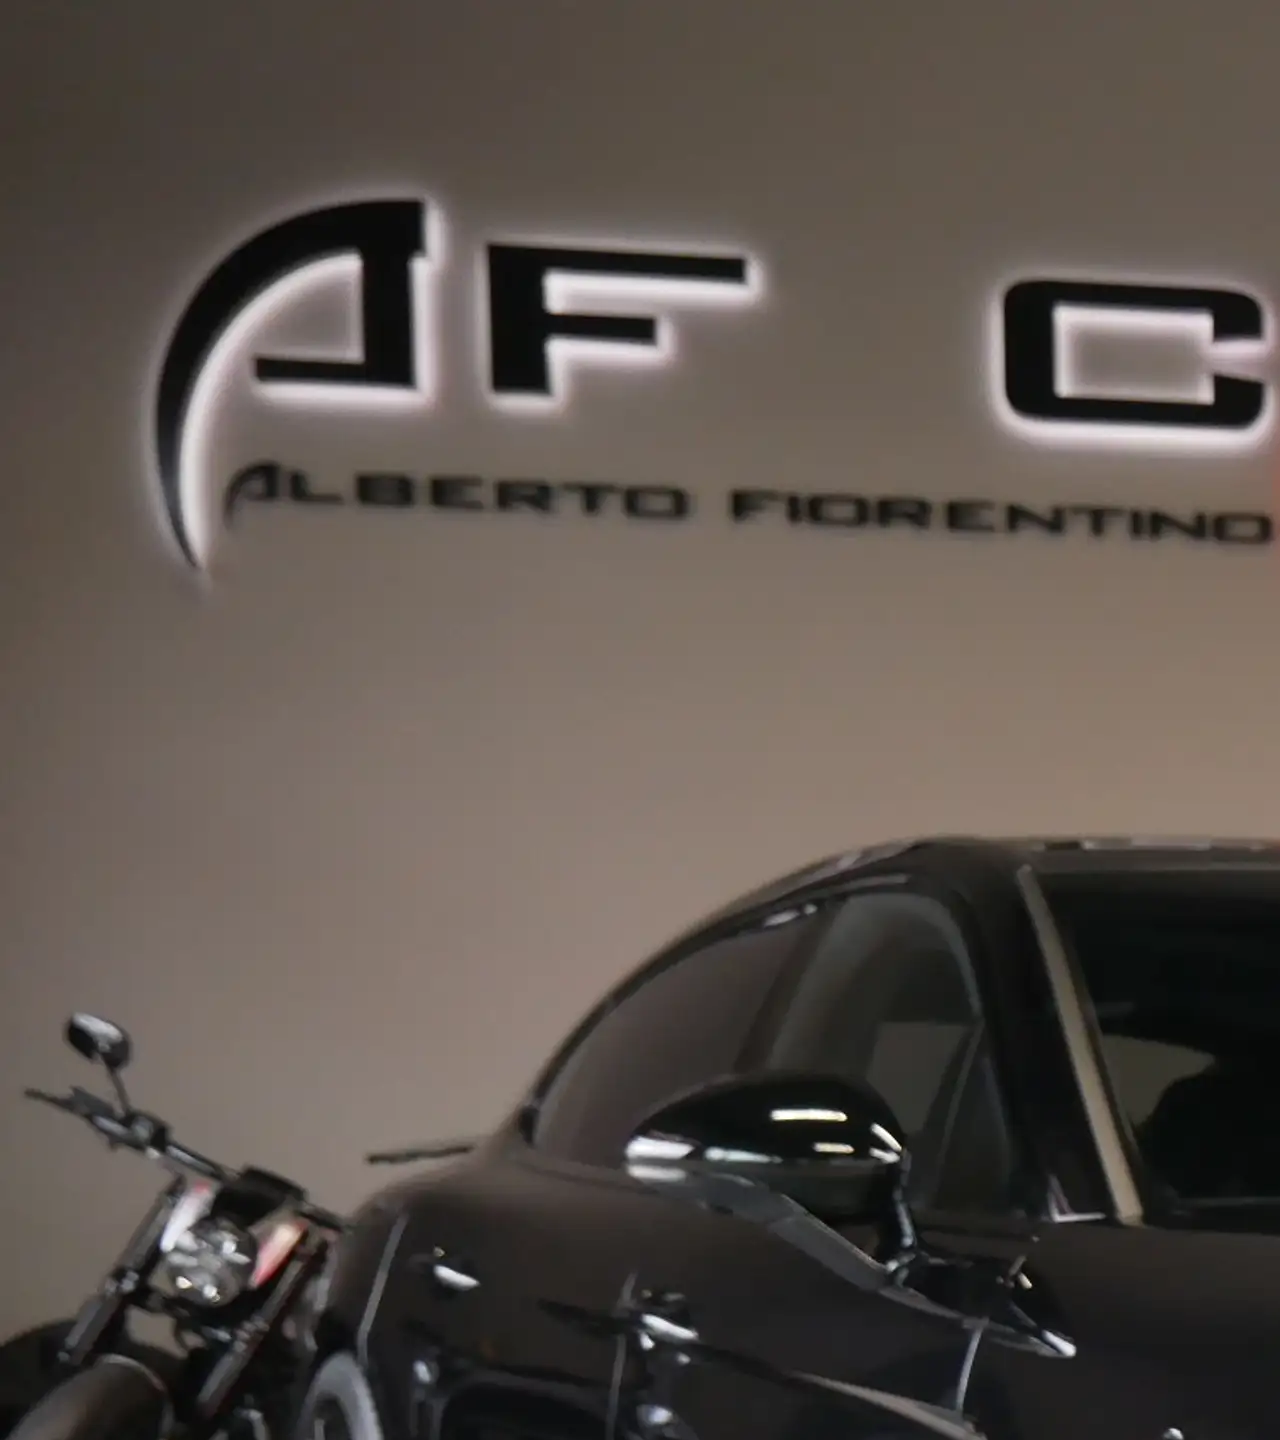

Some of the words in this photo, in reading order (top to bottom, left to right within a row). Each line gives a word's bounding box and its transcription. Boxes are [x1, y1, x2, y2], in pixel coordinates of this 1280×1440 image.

[153, 196, 748, 570] AF
[225, 462, 690, 530] ALBERTO
[730, 488, 1274, 545] FIORENTINO
